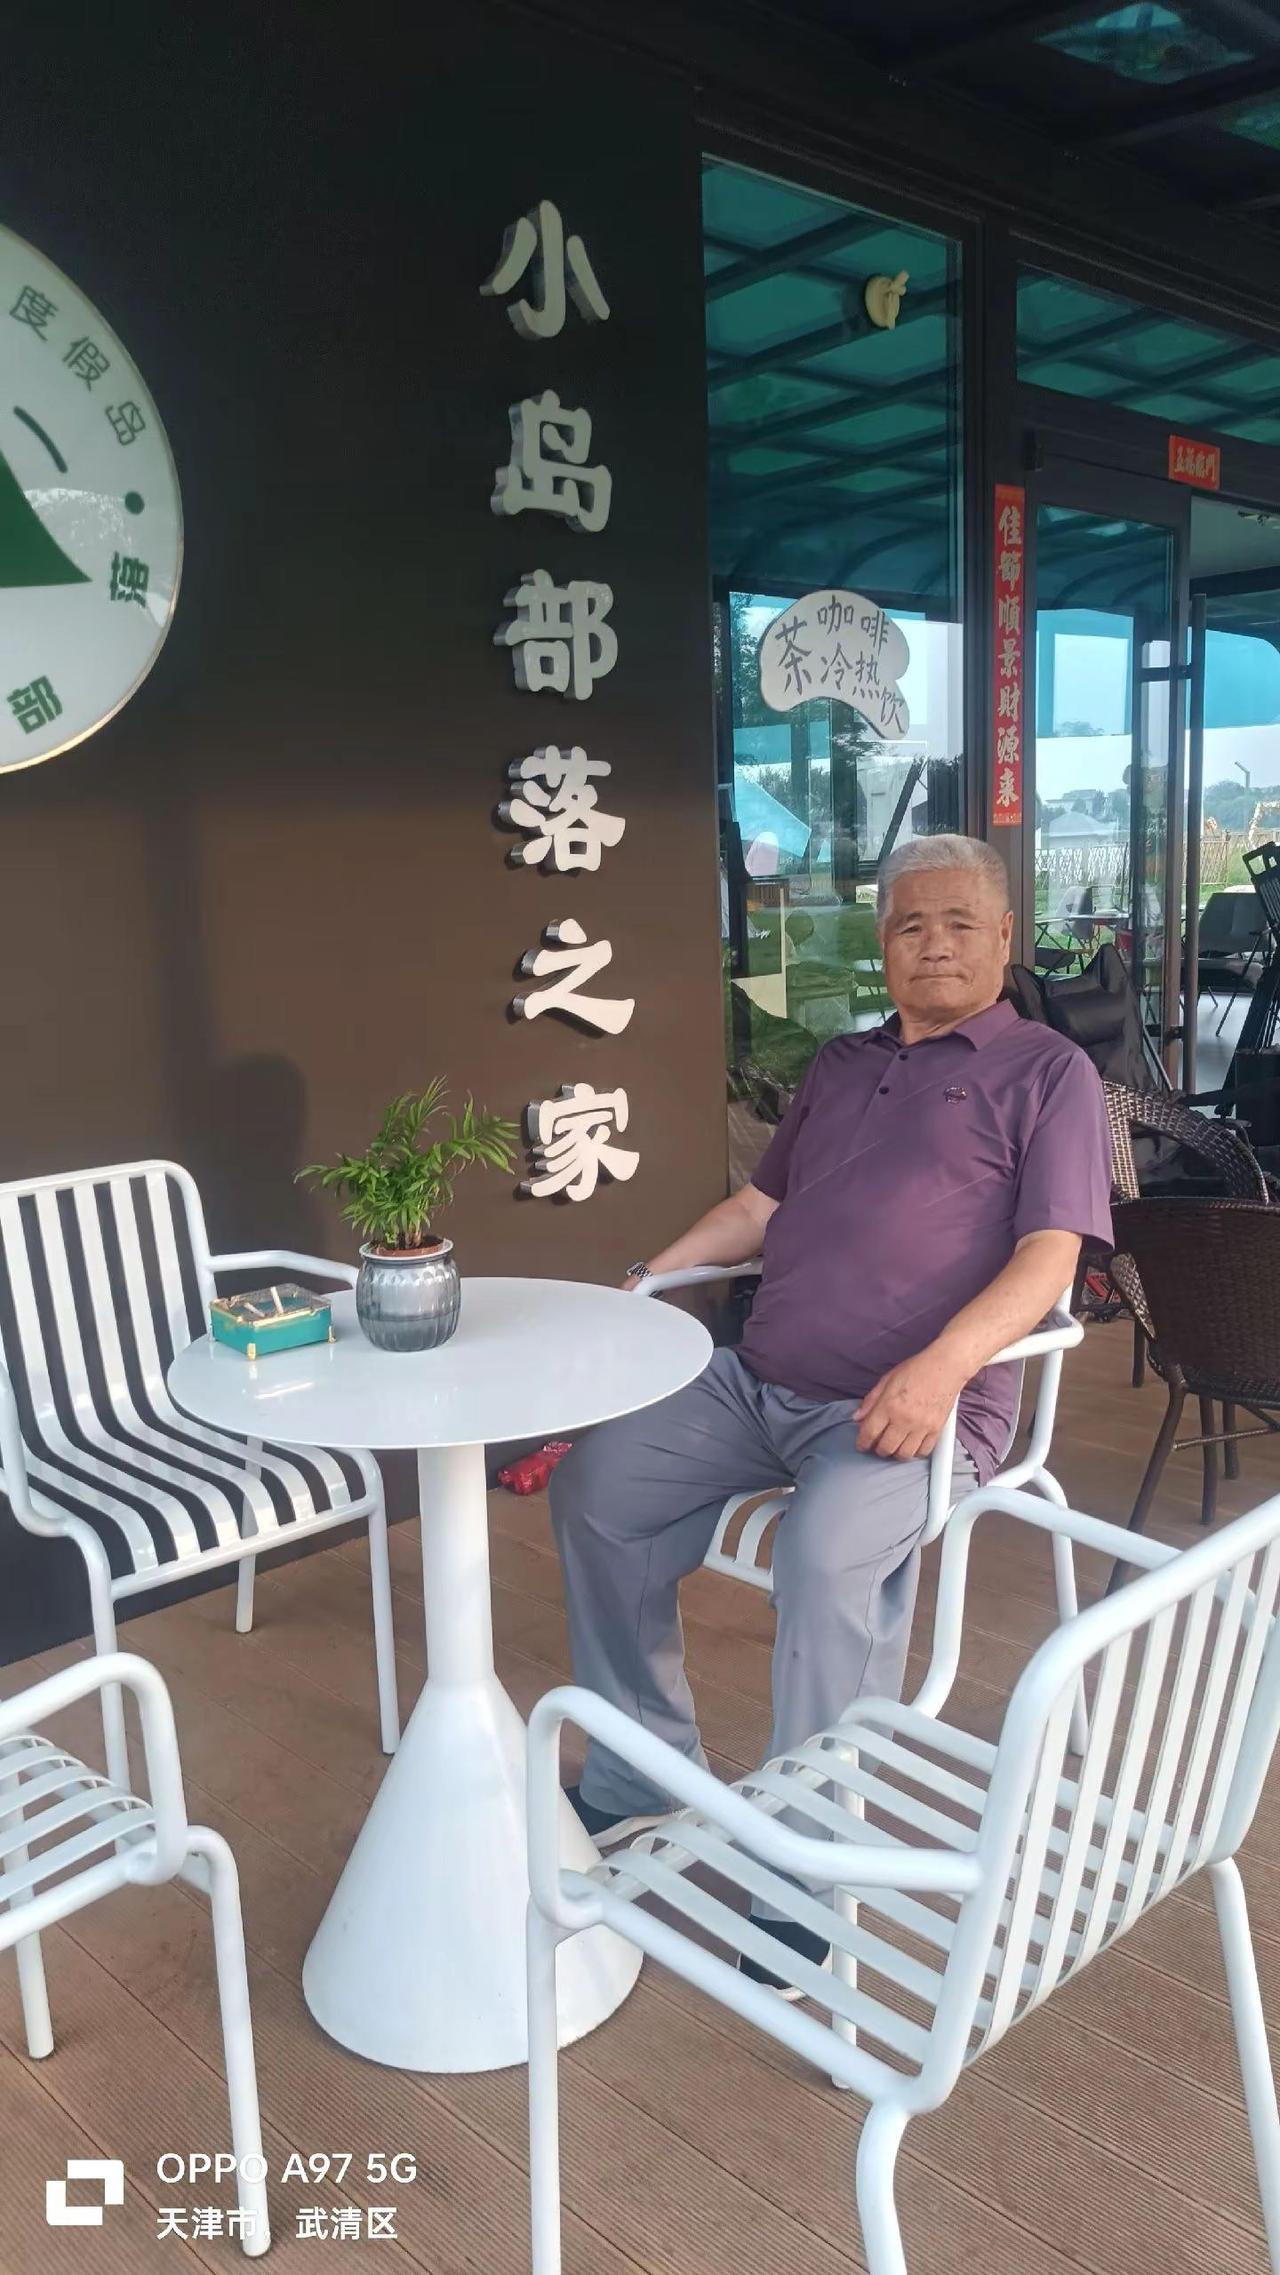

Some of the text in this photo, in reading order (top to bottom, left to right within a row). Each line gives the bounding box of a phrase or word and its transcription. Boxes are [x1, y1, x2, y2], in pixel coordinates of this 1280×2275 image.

[774, 615, 812, 696] 茶
[816, 594, 890, 656] 咖啡
[482, 199, 640, 1203] 小岛部落之家
[820, 642, 906, 735] 冷热饮
